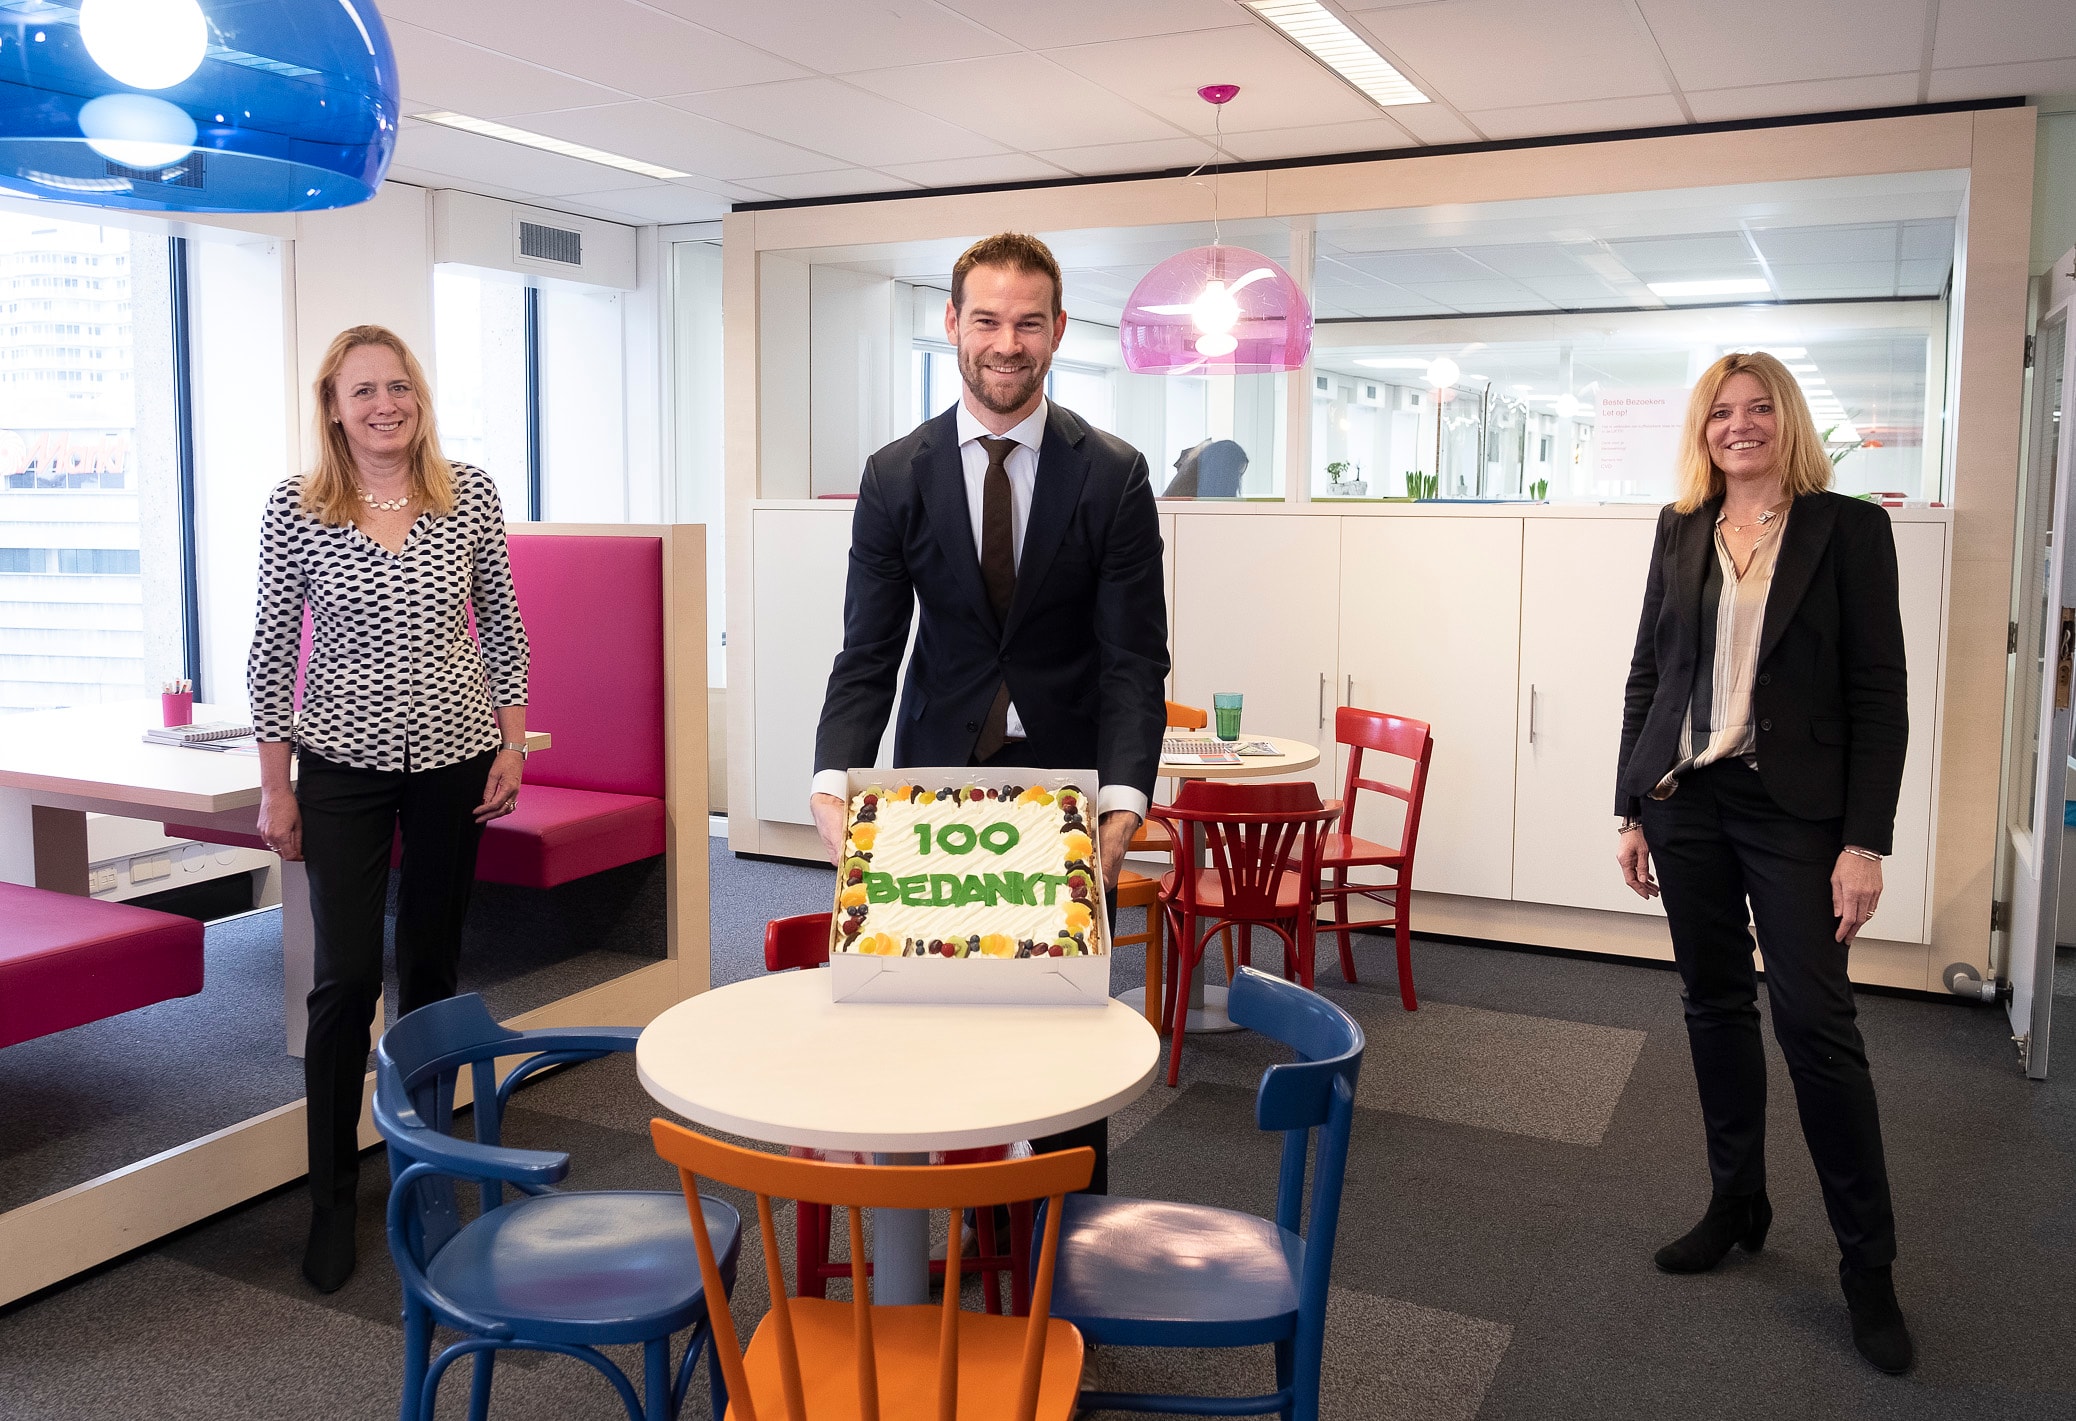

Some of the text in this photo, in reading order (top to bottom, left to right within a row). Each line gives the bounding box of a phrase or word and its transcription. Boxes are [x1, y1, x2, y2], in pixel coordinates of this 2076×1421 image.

[1603, 398, 1665, 406] Beste Bezoekers
[1603, 409, 1628, 417] Let op!
[17, 431, 127, 475] Markt
[914, 821, 1020, 855] 100
[862, 871, 1068, 907] BEDANKT
